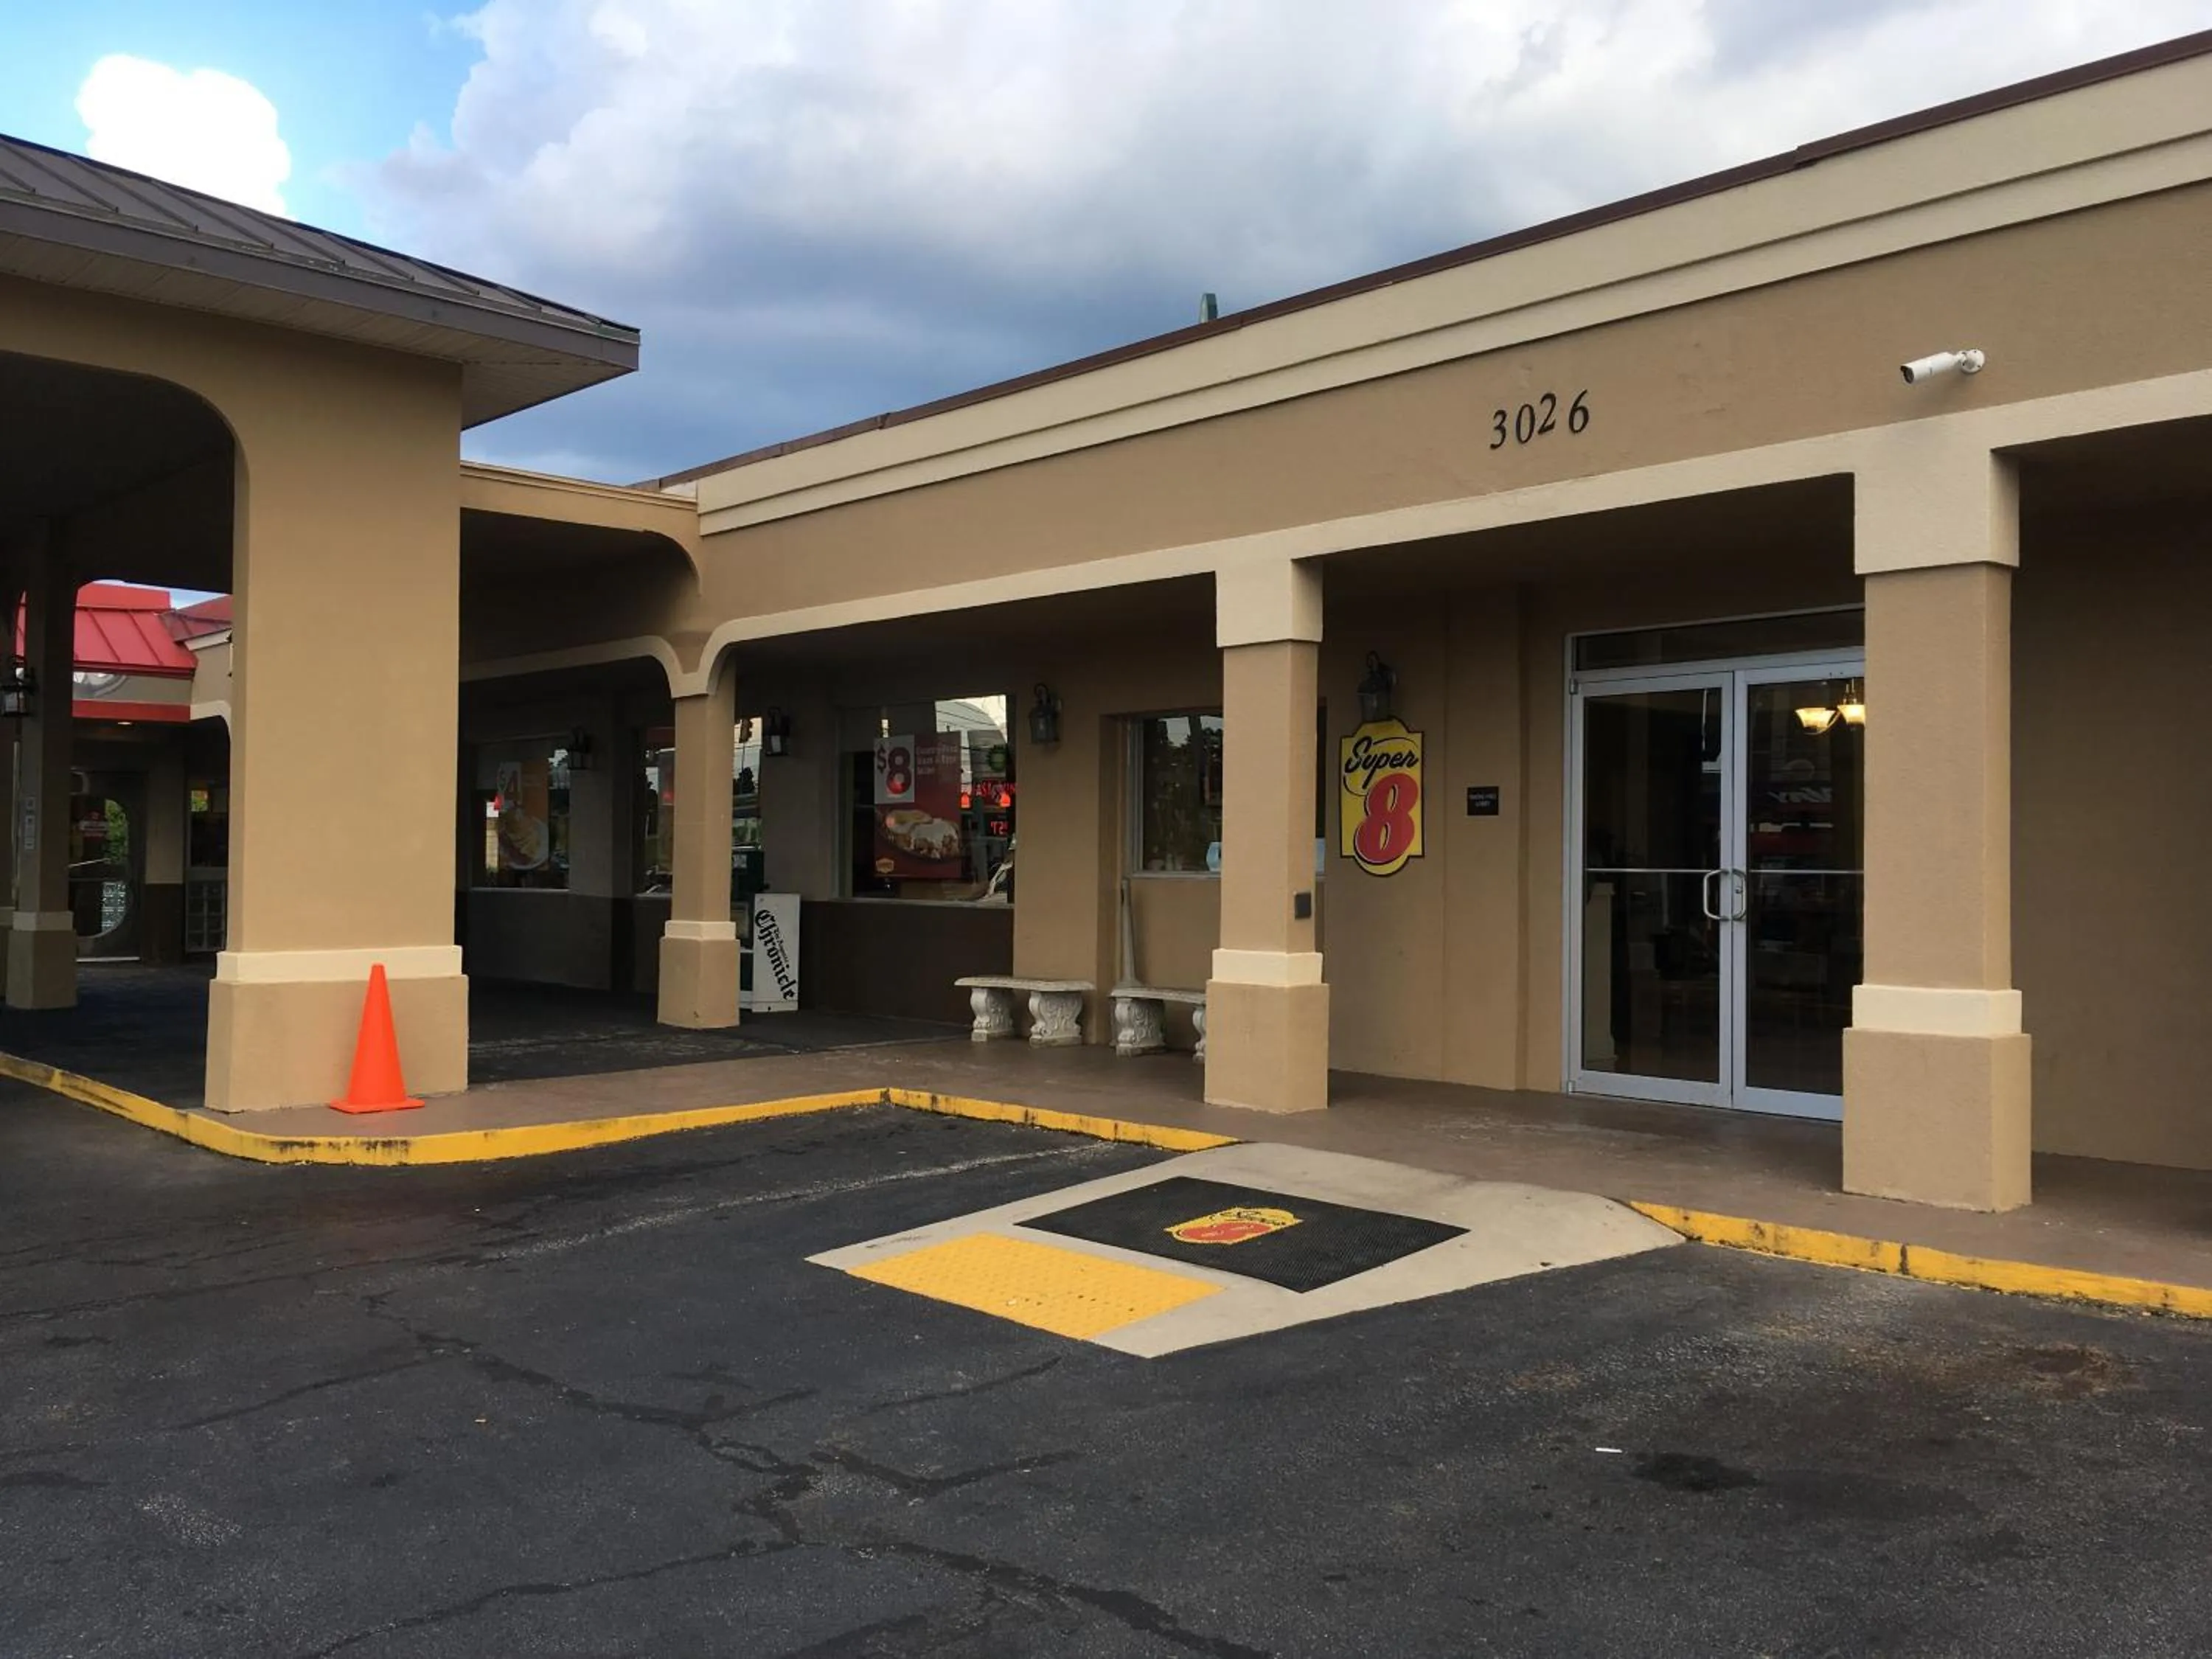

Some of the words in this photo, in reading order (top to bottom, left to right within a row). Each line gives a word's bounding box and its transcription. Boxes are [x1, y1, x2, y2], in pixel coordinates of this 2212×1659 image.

[1489, 389, 1590, 450] 3026
[877, 744, 911, 795] $8
[1344, 736, 1419, 789] Super
[1354, 773, 1419, 865] 8
[755, 909, 796, 1001] Chronicle
